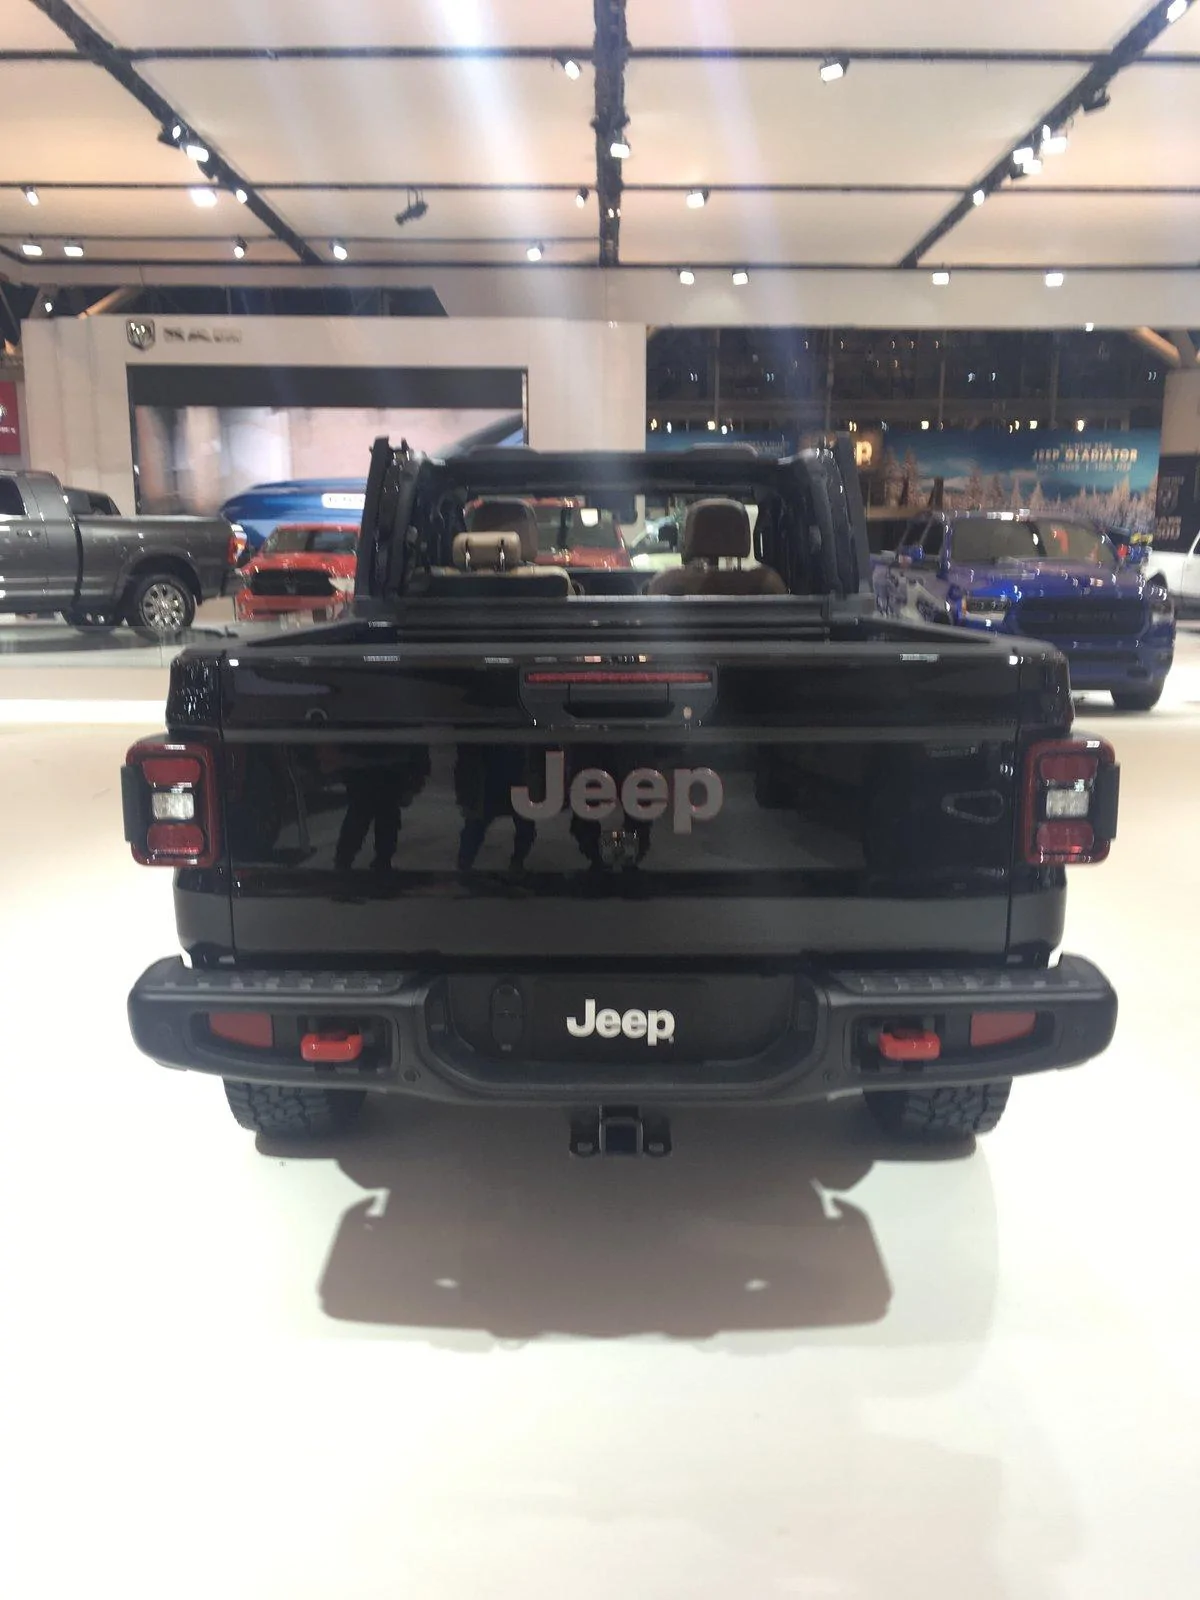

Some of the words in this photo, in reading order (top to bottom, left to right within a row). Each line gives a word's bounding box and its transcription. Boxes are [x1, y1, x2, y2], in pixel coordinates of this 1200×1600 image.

[1065, 448, 1138, 462] GLADIATOR
[510, 750, 724, 834] Jeep
[566, 998, 676, 1046] Jeep
